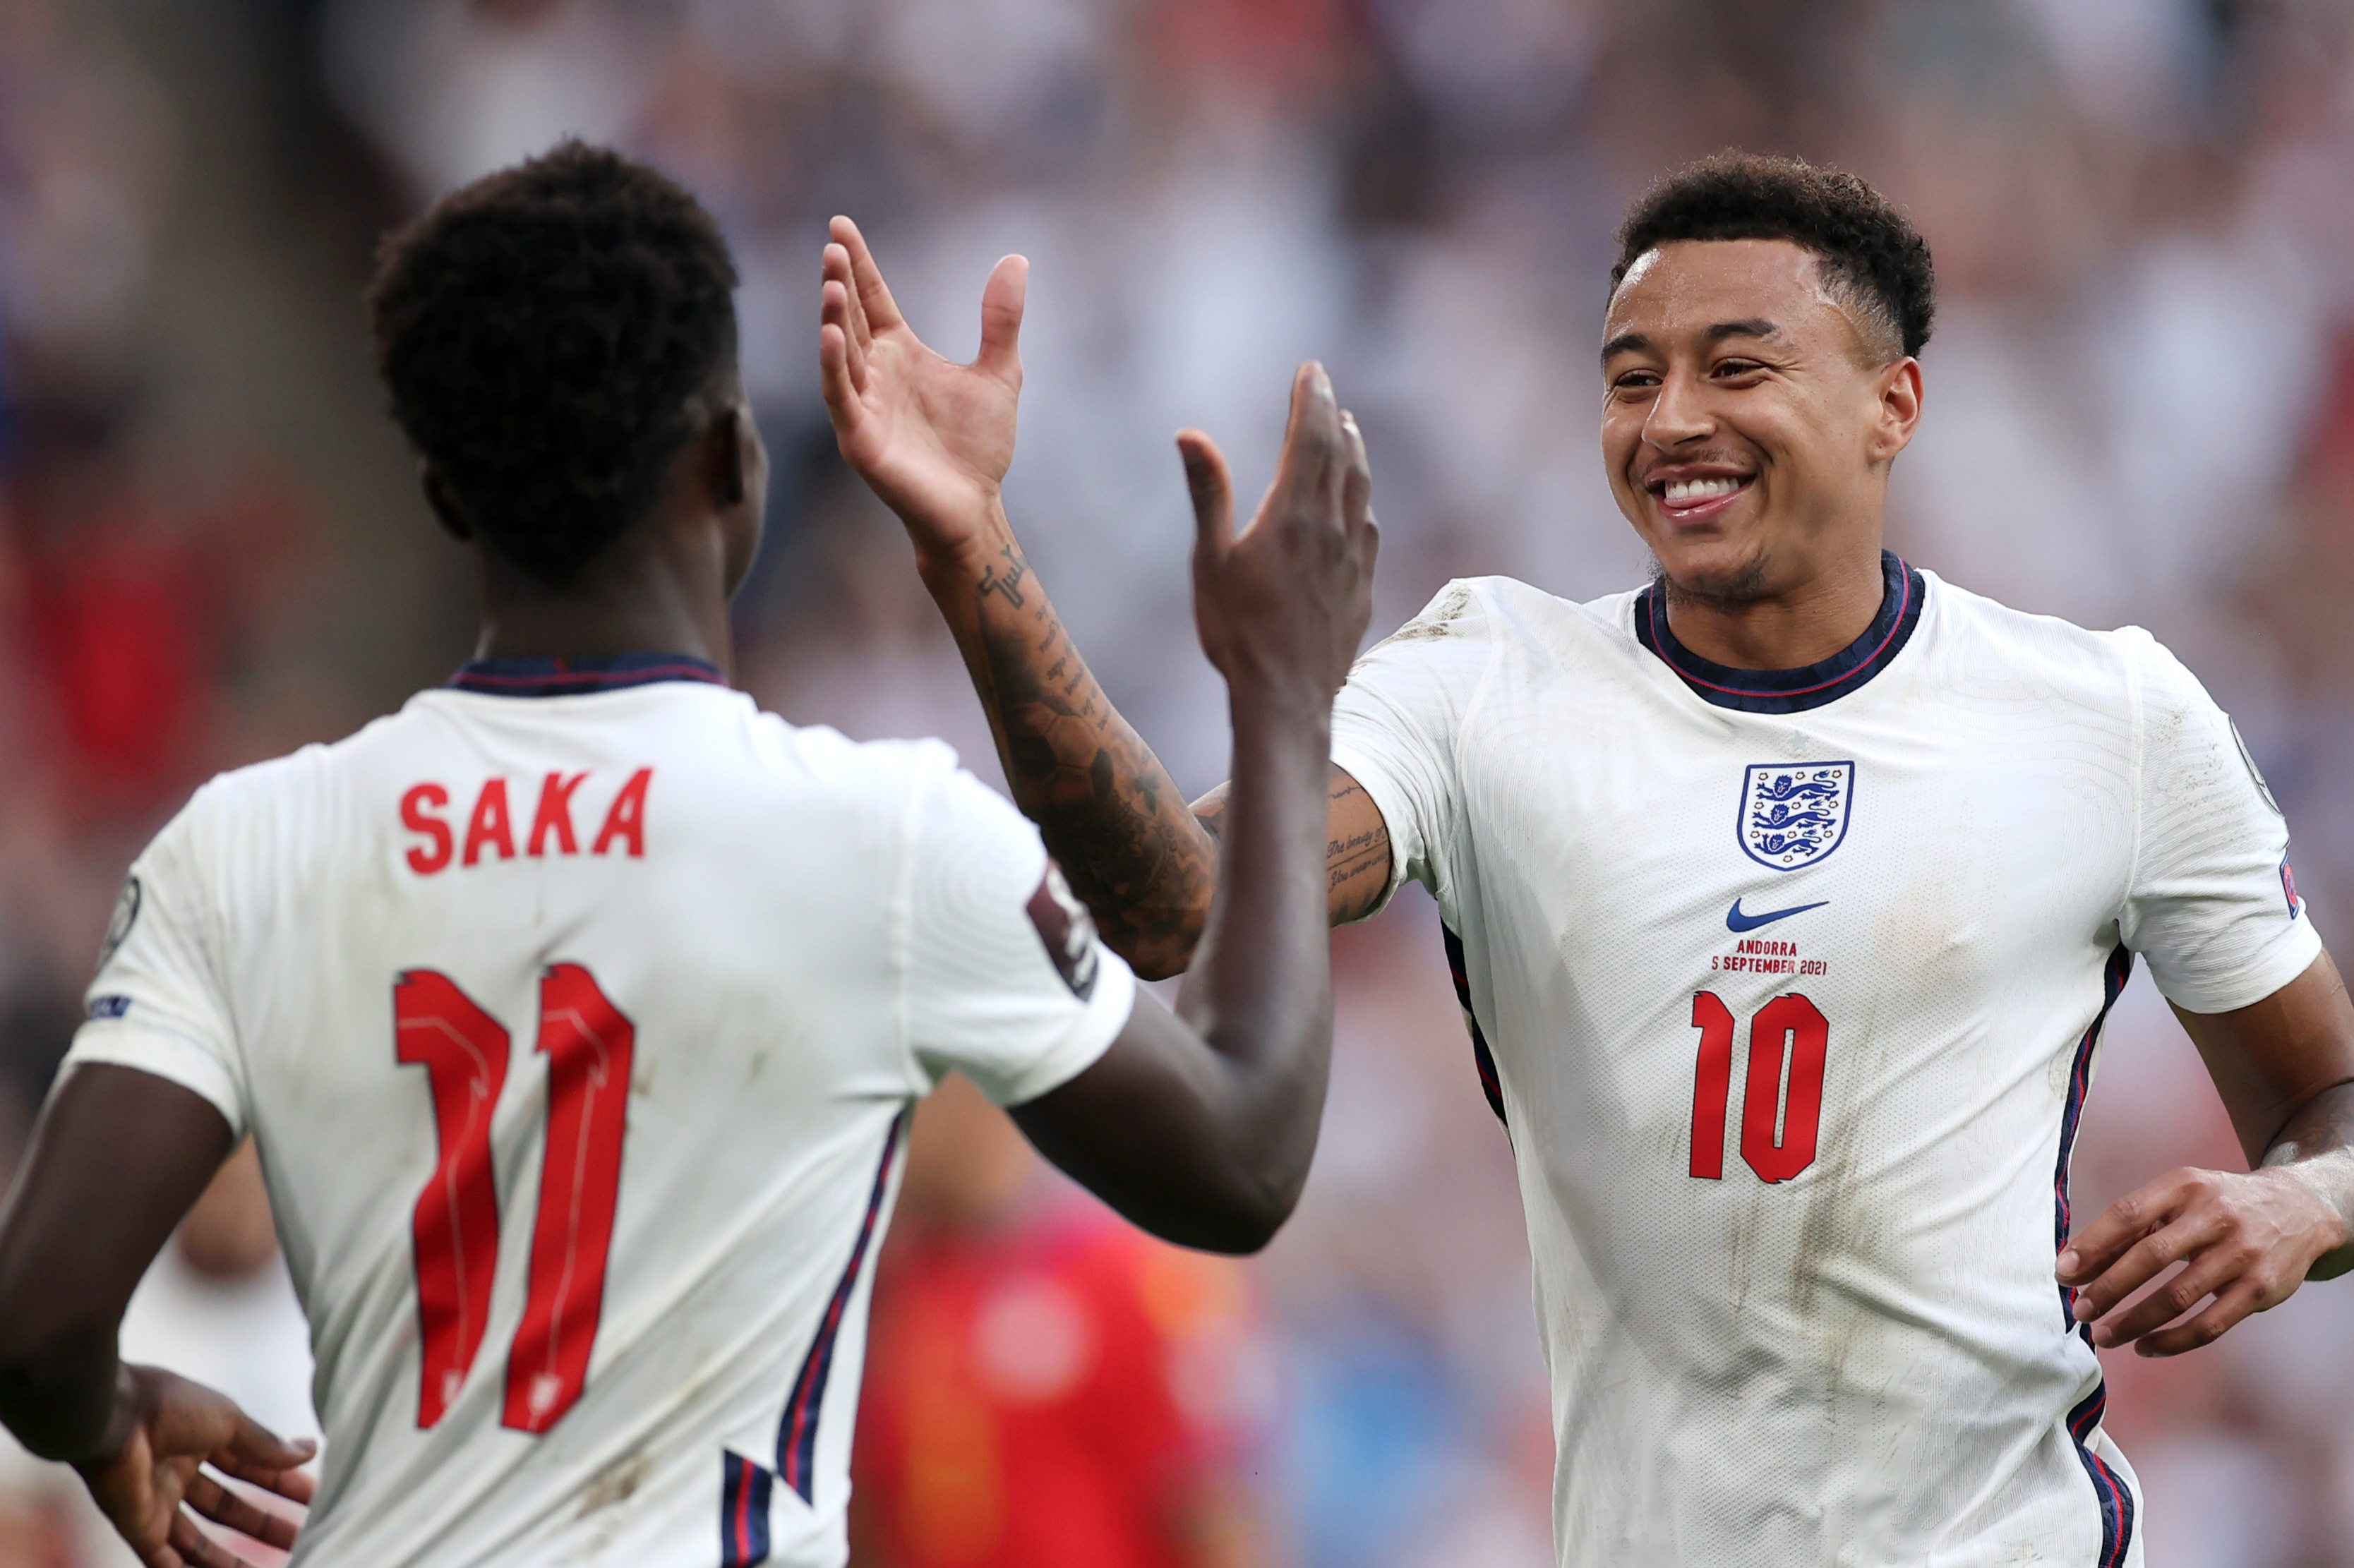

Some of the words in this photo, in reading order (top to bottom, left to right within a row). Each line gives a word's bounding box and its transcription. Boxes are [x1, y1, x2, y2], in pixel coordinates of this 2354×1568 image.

[399, 766, 654, 876] SAKA
[1712, 955, 1719, 970] 5
[1723, 956, 1796, 974] SEPTEMBER
[1800, 960, 1827, 976] 2021
[1736, 939, 1797, 957] ANDORRA
[1689, 991, 1830, 1185] 10
[394, 962, 636, 1435] 11
